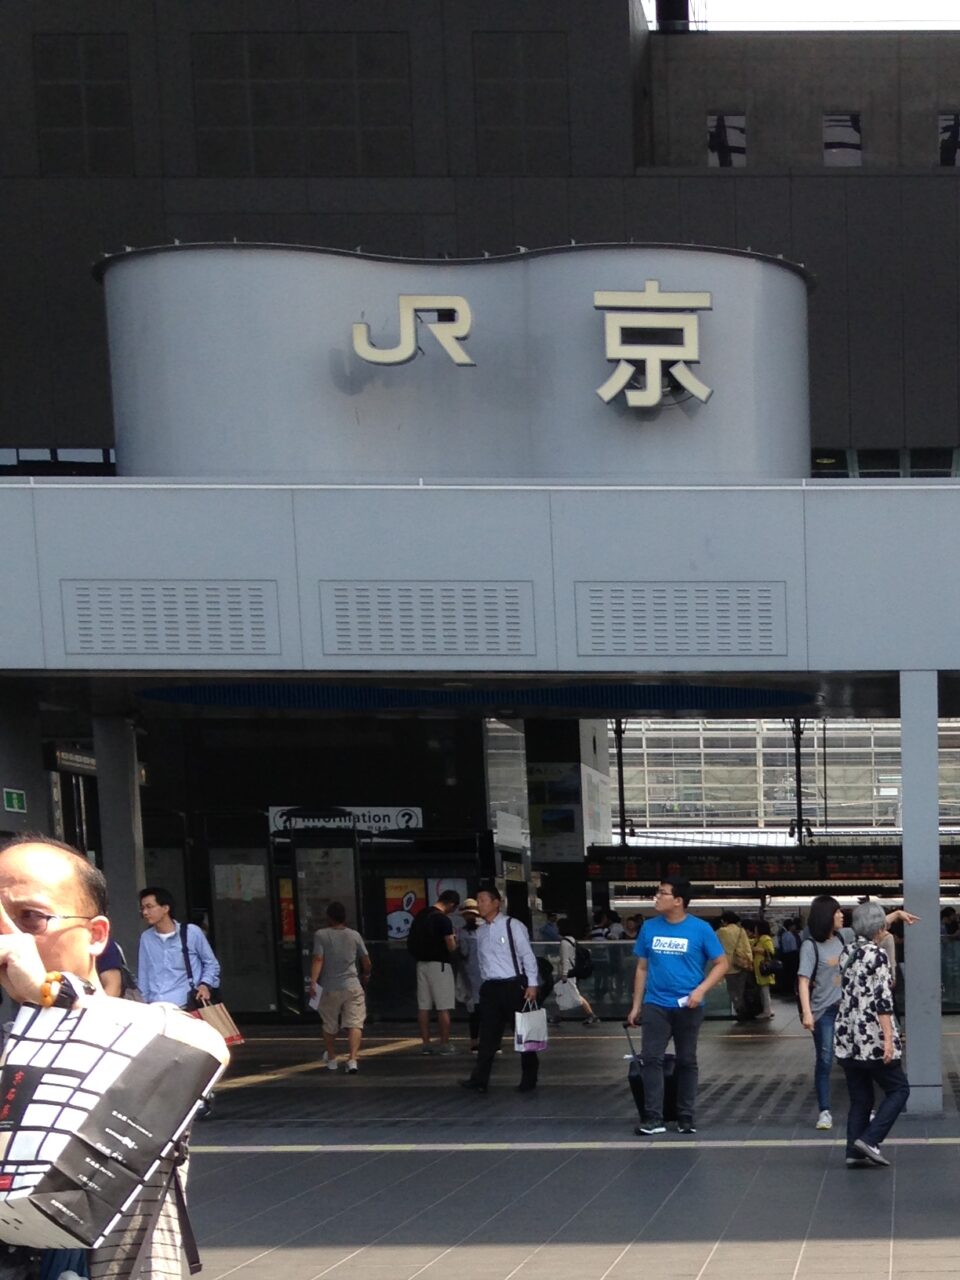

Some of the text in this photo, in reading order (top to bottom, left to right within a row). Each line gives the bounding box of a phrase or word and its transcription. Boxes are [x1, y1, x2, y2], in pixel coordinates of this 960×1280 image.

[353, 295, 476, 366] JR
[594, 279, 713, 407] 京
[653, 938, 686, 950] Dickies
